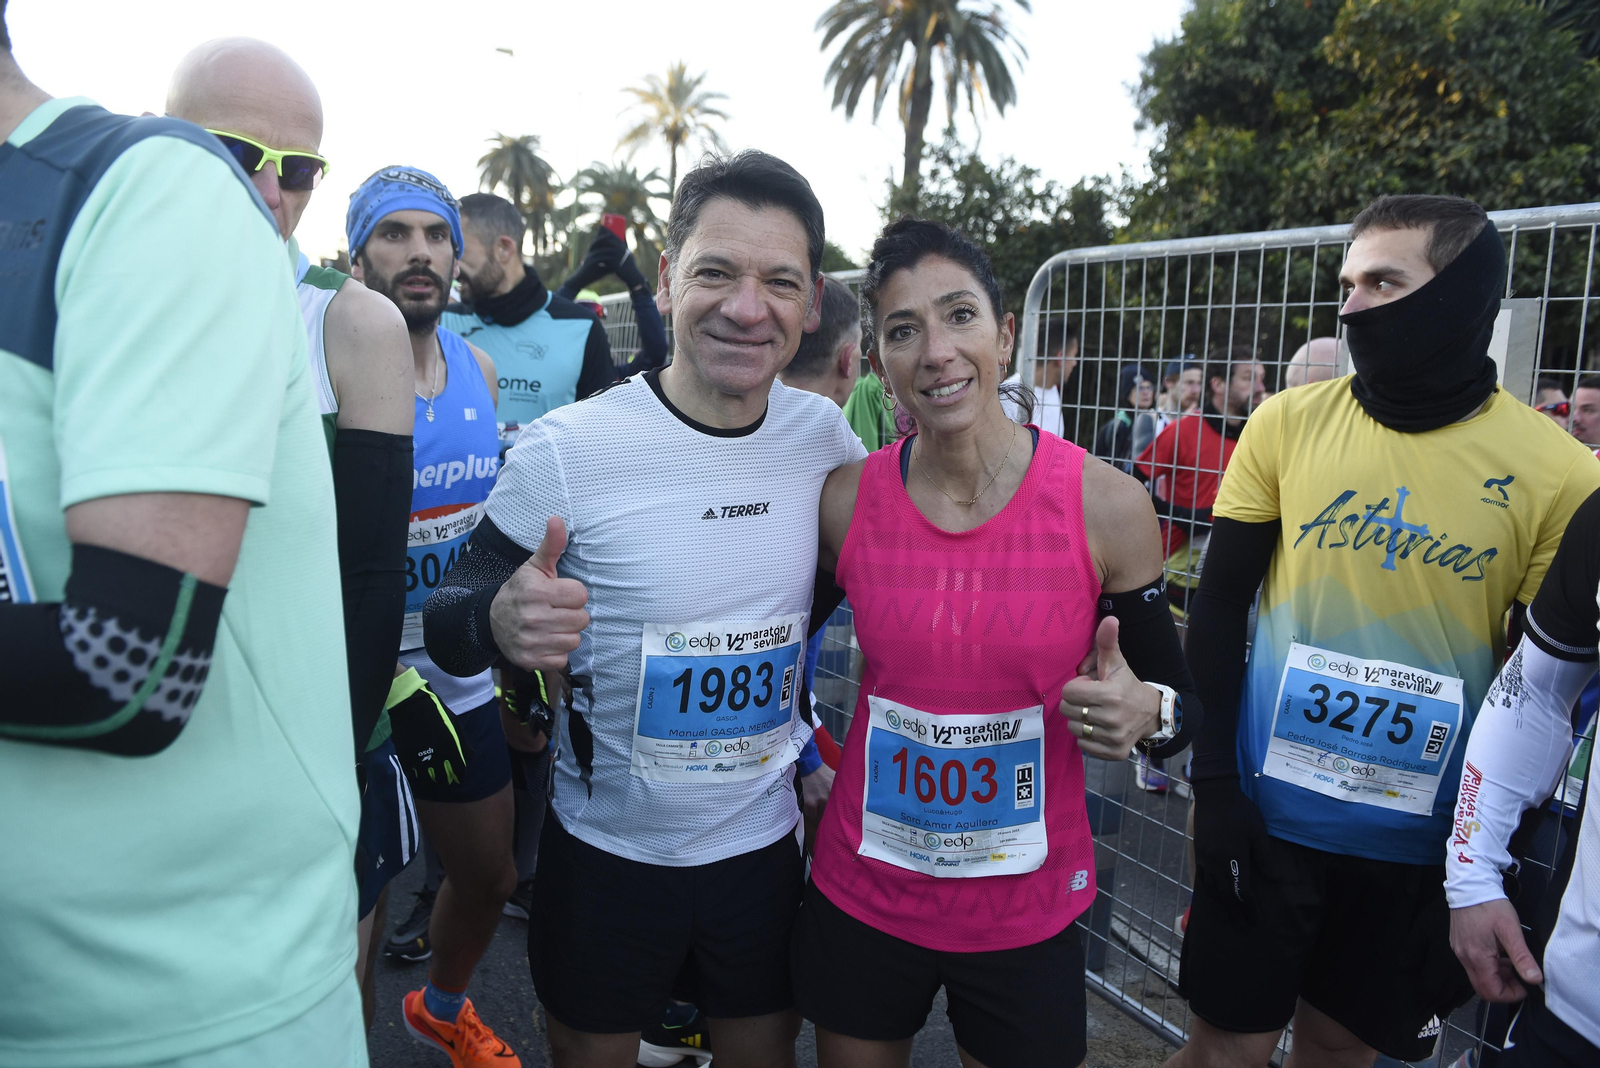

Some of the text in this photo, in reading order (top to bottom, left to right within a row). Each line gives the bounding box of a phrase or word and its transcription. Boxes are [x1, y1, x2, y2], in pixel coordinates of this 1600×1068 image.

[721, 502, 770, 518] TERREX
[1294, 490, 1498, 582] Asturias
[406, 540, 467, 592] 304
[688, 631, 720, 652] edp
[743, 625, 786, 641] maratón
[753, 629, 786, 649] sevilla
[1328, 661, 1358, 678] edp
[1378, 666, 1432, 685] maratón
[673, 661, 774, 714] 1983
[1390, 676, 1432, 695] sevilla
[1303, 683, 1417, 745] 3275
[669, 728, 708, 738] Manuel
[710, 727, 746, 737] GASCA
[902, 718, 927, 739] edp
[949, 720, 1010, 735] maratón
[964, 728, 1011, 745] sevilla
[724, 738, 750, 754] edp
[1342, 735, 1360, 745] Pedro
[1287, 731, 1315, 744] Pedro
[1318, 738, 1338, 750] José
[1341, 746, 1377, 761] Barroso
[1379, 756, 1427, 772] Rodríguez
[685, 764, 708, 772] HOKA
[892, 746, 998, 806] 1603
[1351, 764, 1376, 779] edp
[1313, 772, 1335, 784] HOKA
[1465, 777, 1482, 818] sevilla
[900, 812, 999, 830] Sara Amar Aguilera
[943, 832, 973, 850] edp
[909, 851, 931, 863] HOKA
[1417, 1026, 1441, 1039] adidas
